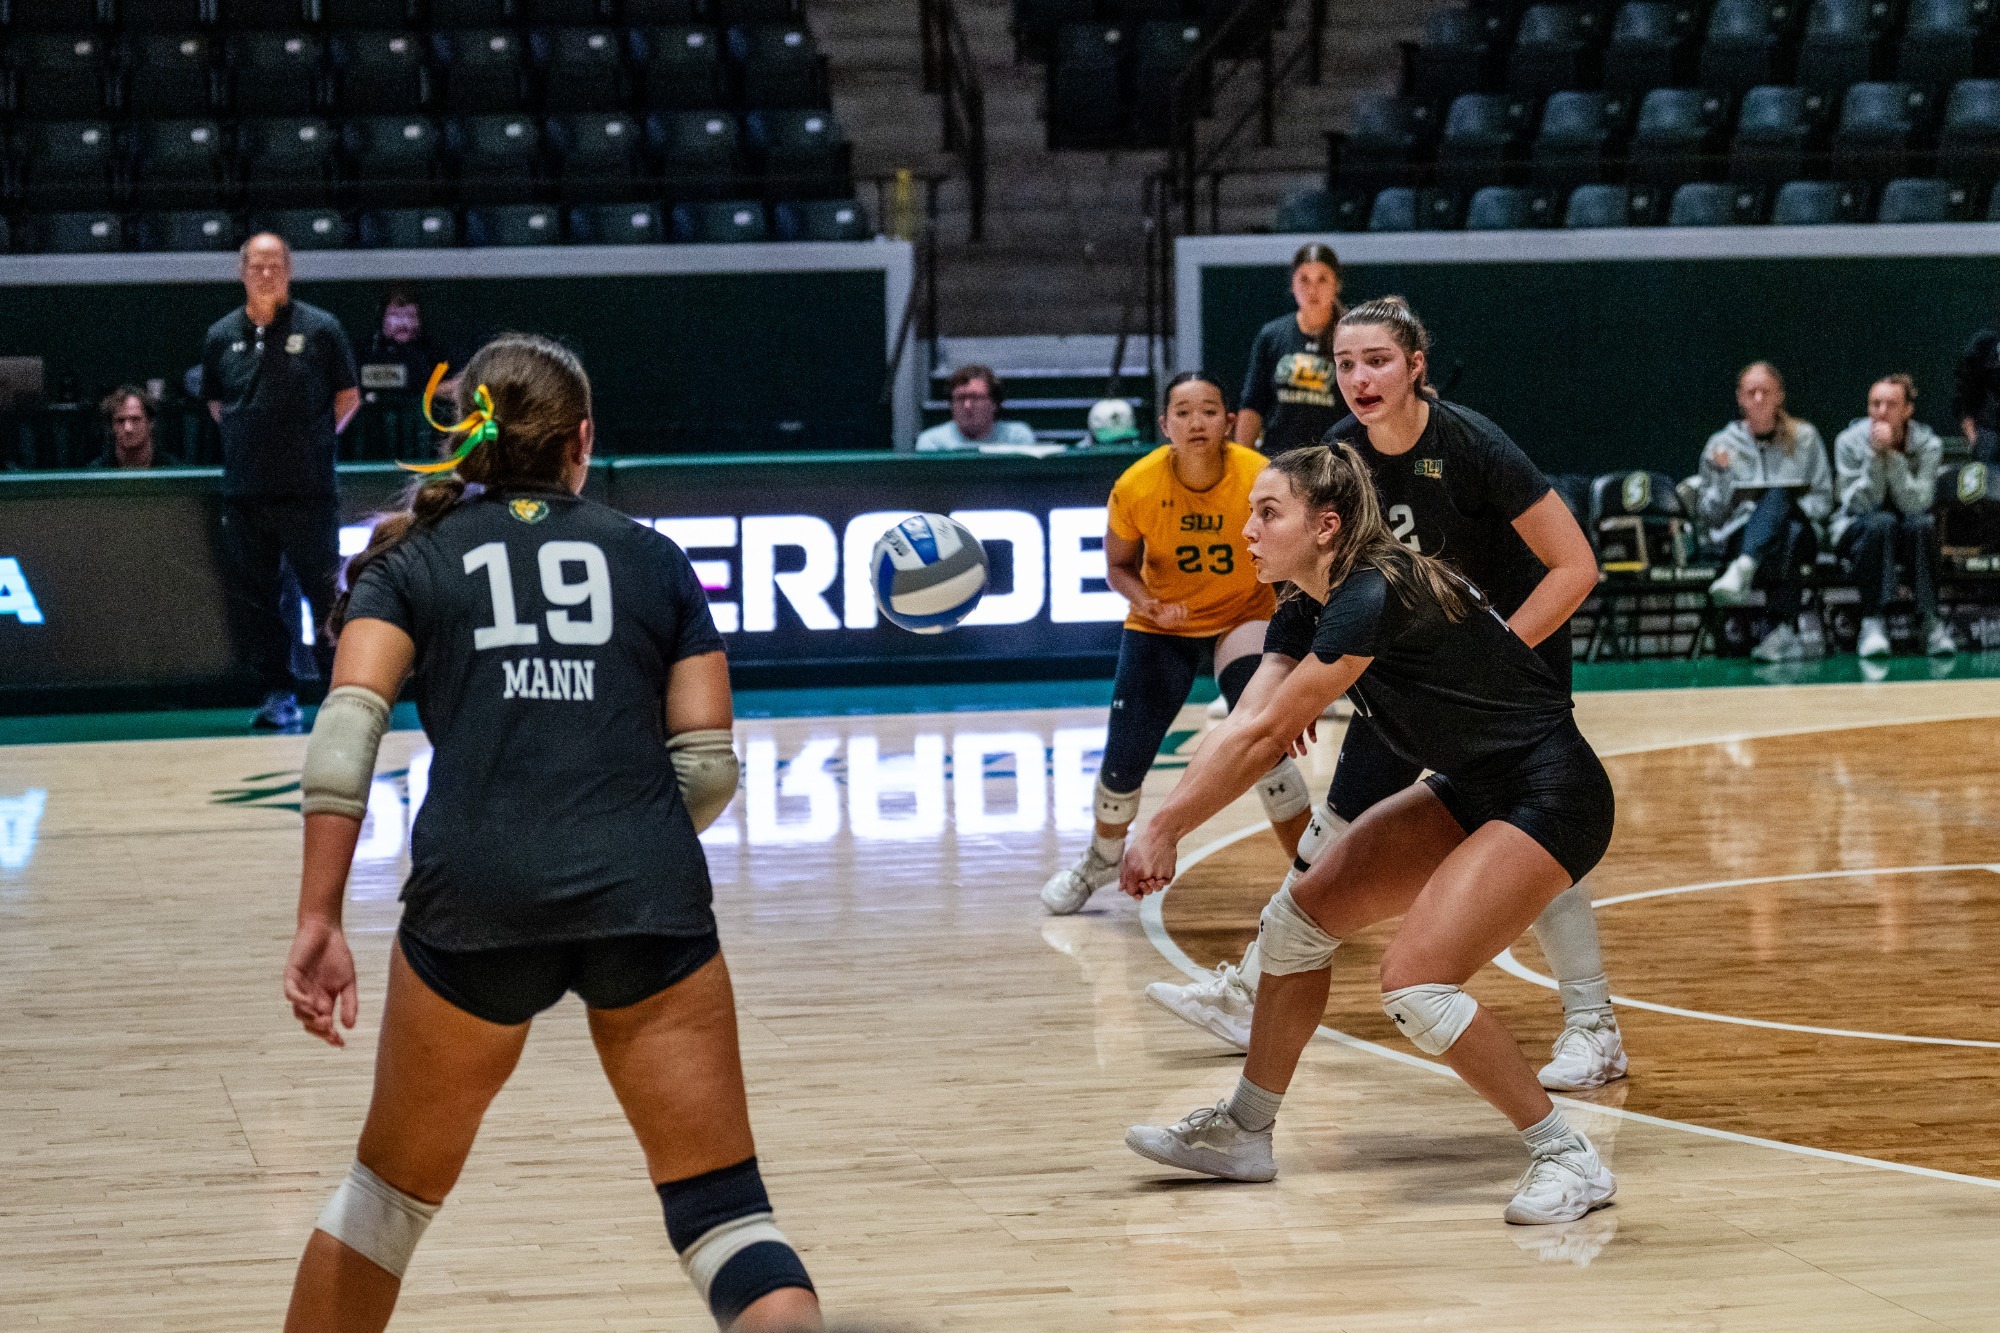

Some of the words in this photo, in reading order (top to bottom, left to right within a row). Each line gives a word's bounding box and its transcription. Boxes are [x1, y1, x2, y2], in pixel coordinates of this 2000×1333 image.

[1175, 543, 1234, 575] 23
[462, 540, 614, 651] 19
[501, 657, 595, 700] MANN
